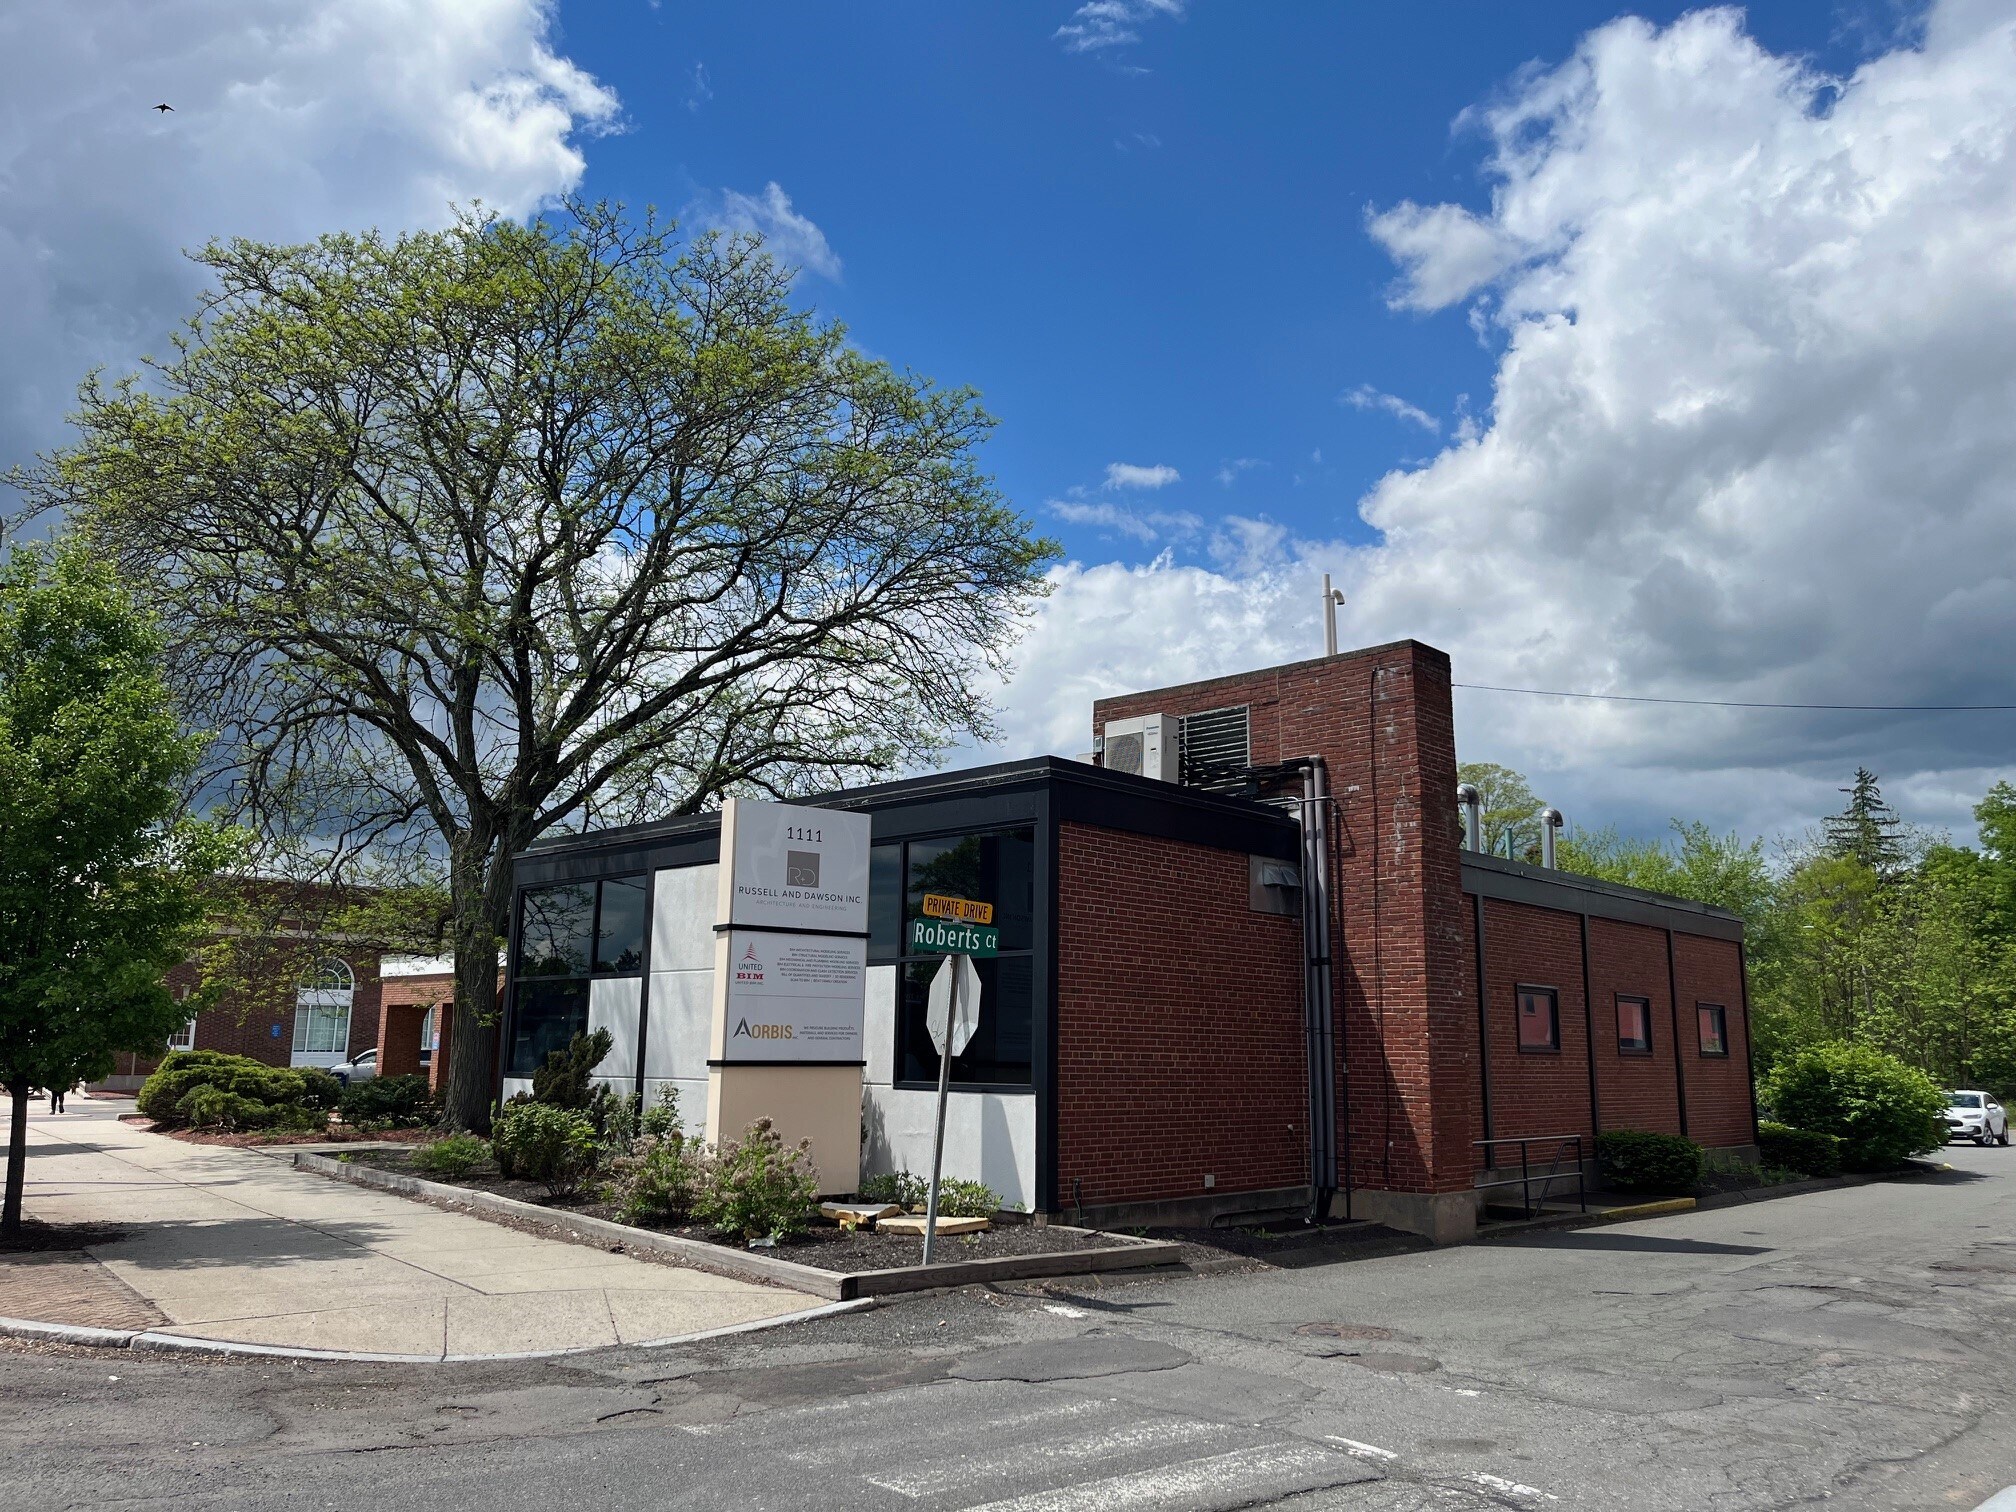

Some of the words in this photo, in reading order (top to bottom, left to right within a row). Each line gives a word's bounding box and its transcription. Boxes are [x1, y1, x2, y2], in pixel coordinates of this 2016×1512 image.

[788, 827, 823, 842] 1111
[738, 886, 778, 897] RUSSELL
[782, 890, 801, 899] AND
[804, 892, 843, 902] DAWSON
[846, 895, 862, 904] INC.
[812, 903, 847, 911] ENGINEERING
[927, 898, 960, 915] PRIVATE
[964, 902, 988, 920] DRIVE
[915, 923, 980, 950] Roberts
[986, 934, 997, 949] Ct
